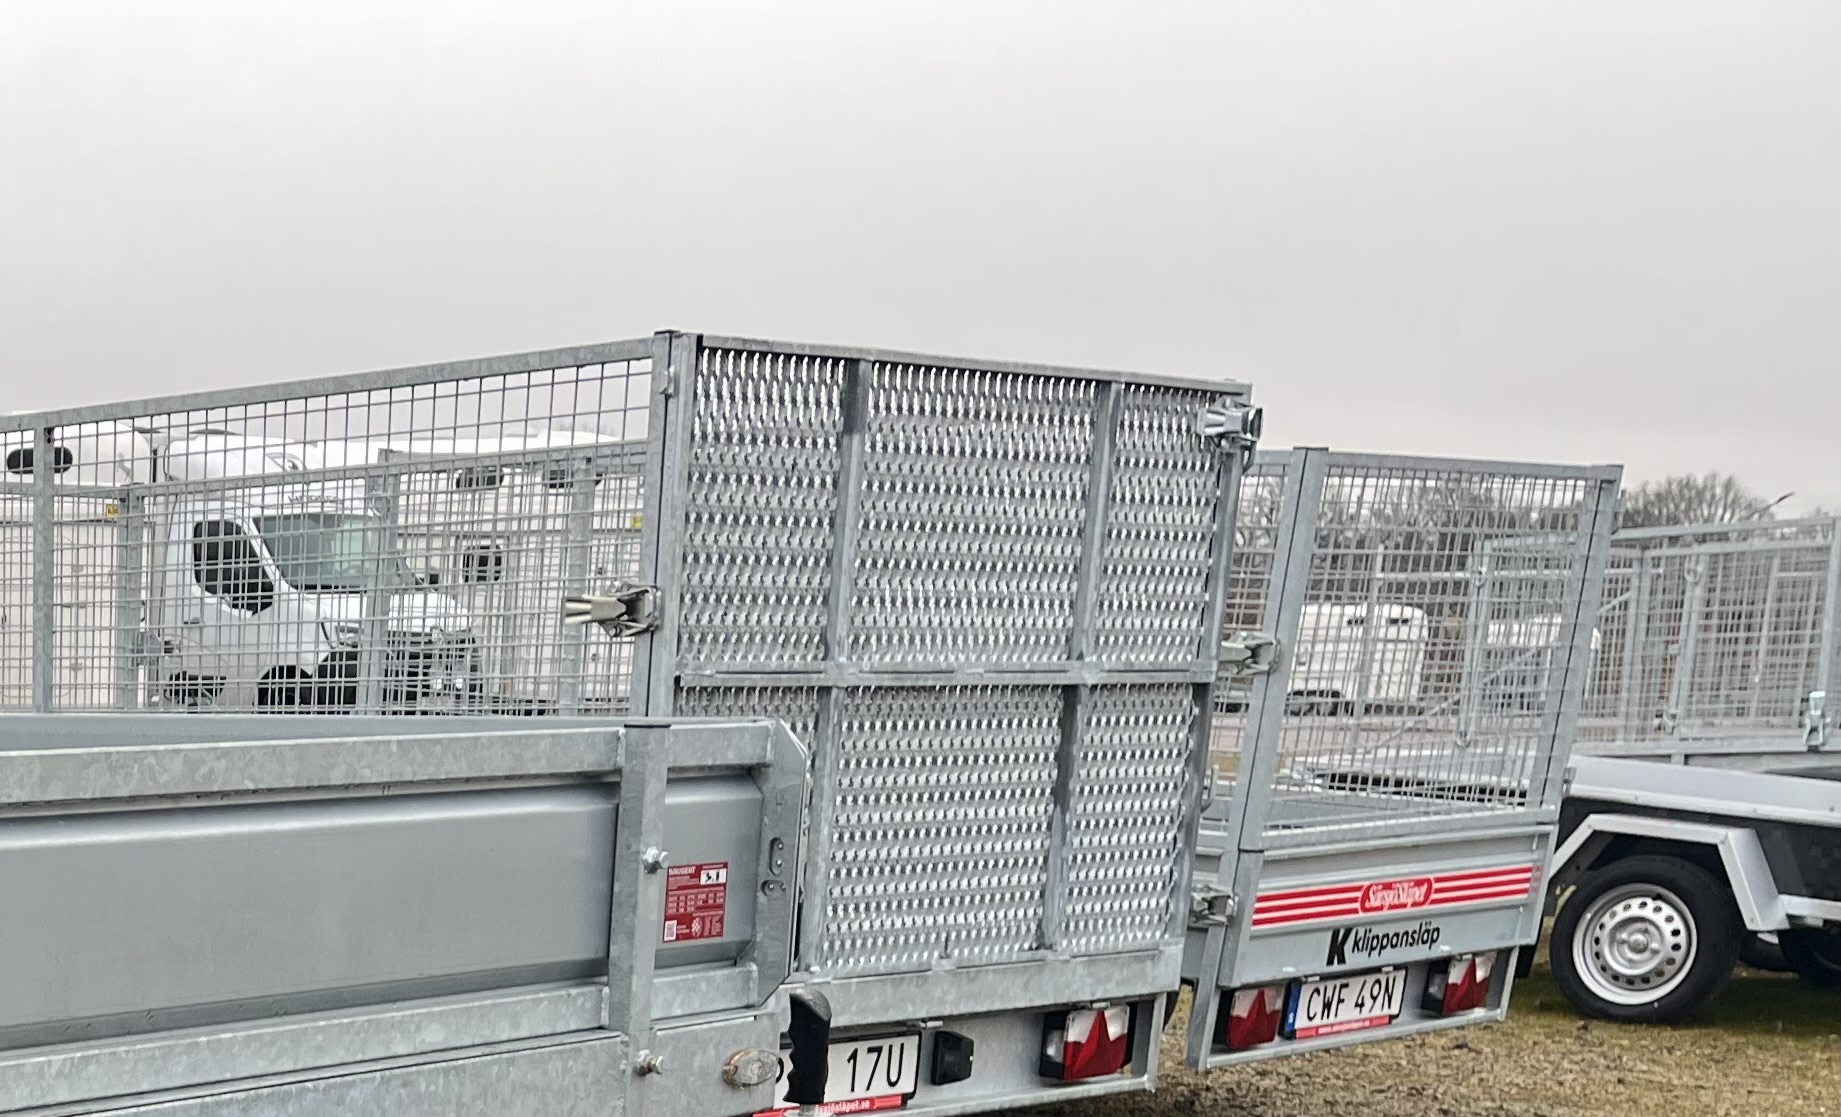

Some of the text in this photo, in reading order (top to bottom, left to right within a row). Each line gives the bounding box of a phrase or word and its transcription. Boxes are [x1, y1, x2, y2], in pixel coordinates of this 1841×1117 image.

[1326, 920, 1440, 967] K klippansläp
[1307, 975, 1396, 1022] CWF 49N
[847, 1042, 905, 1093] 17U
